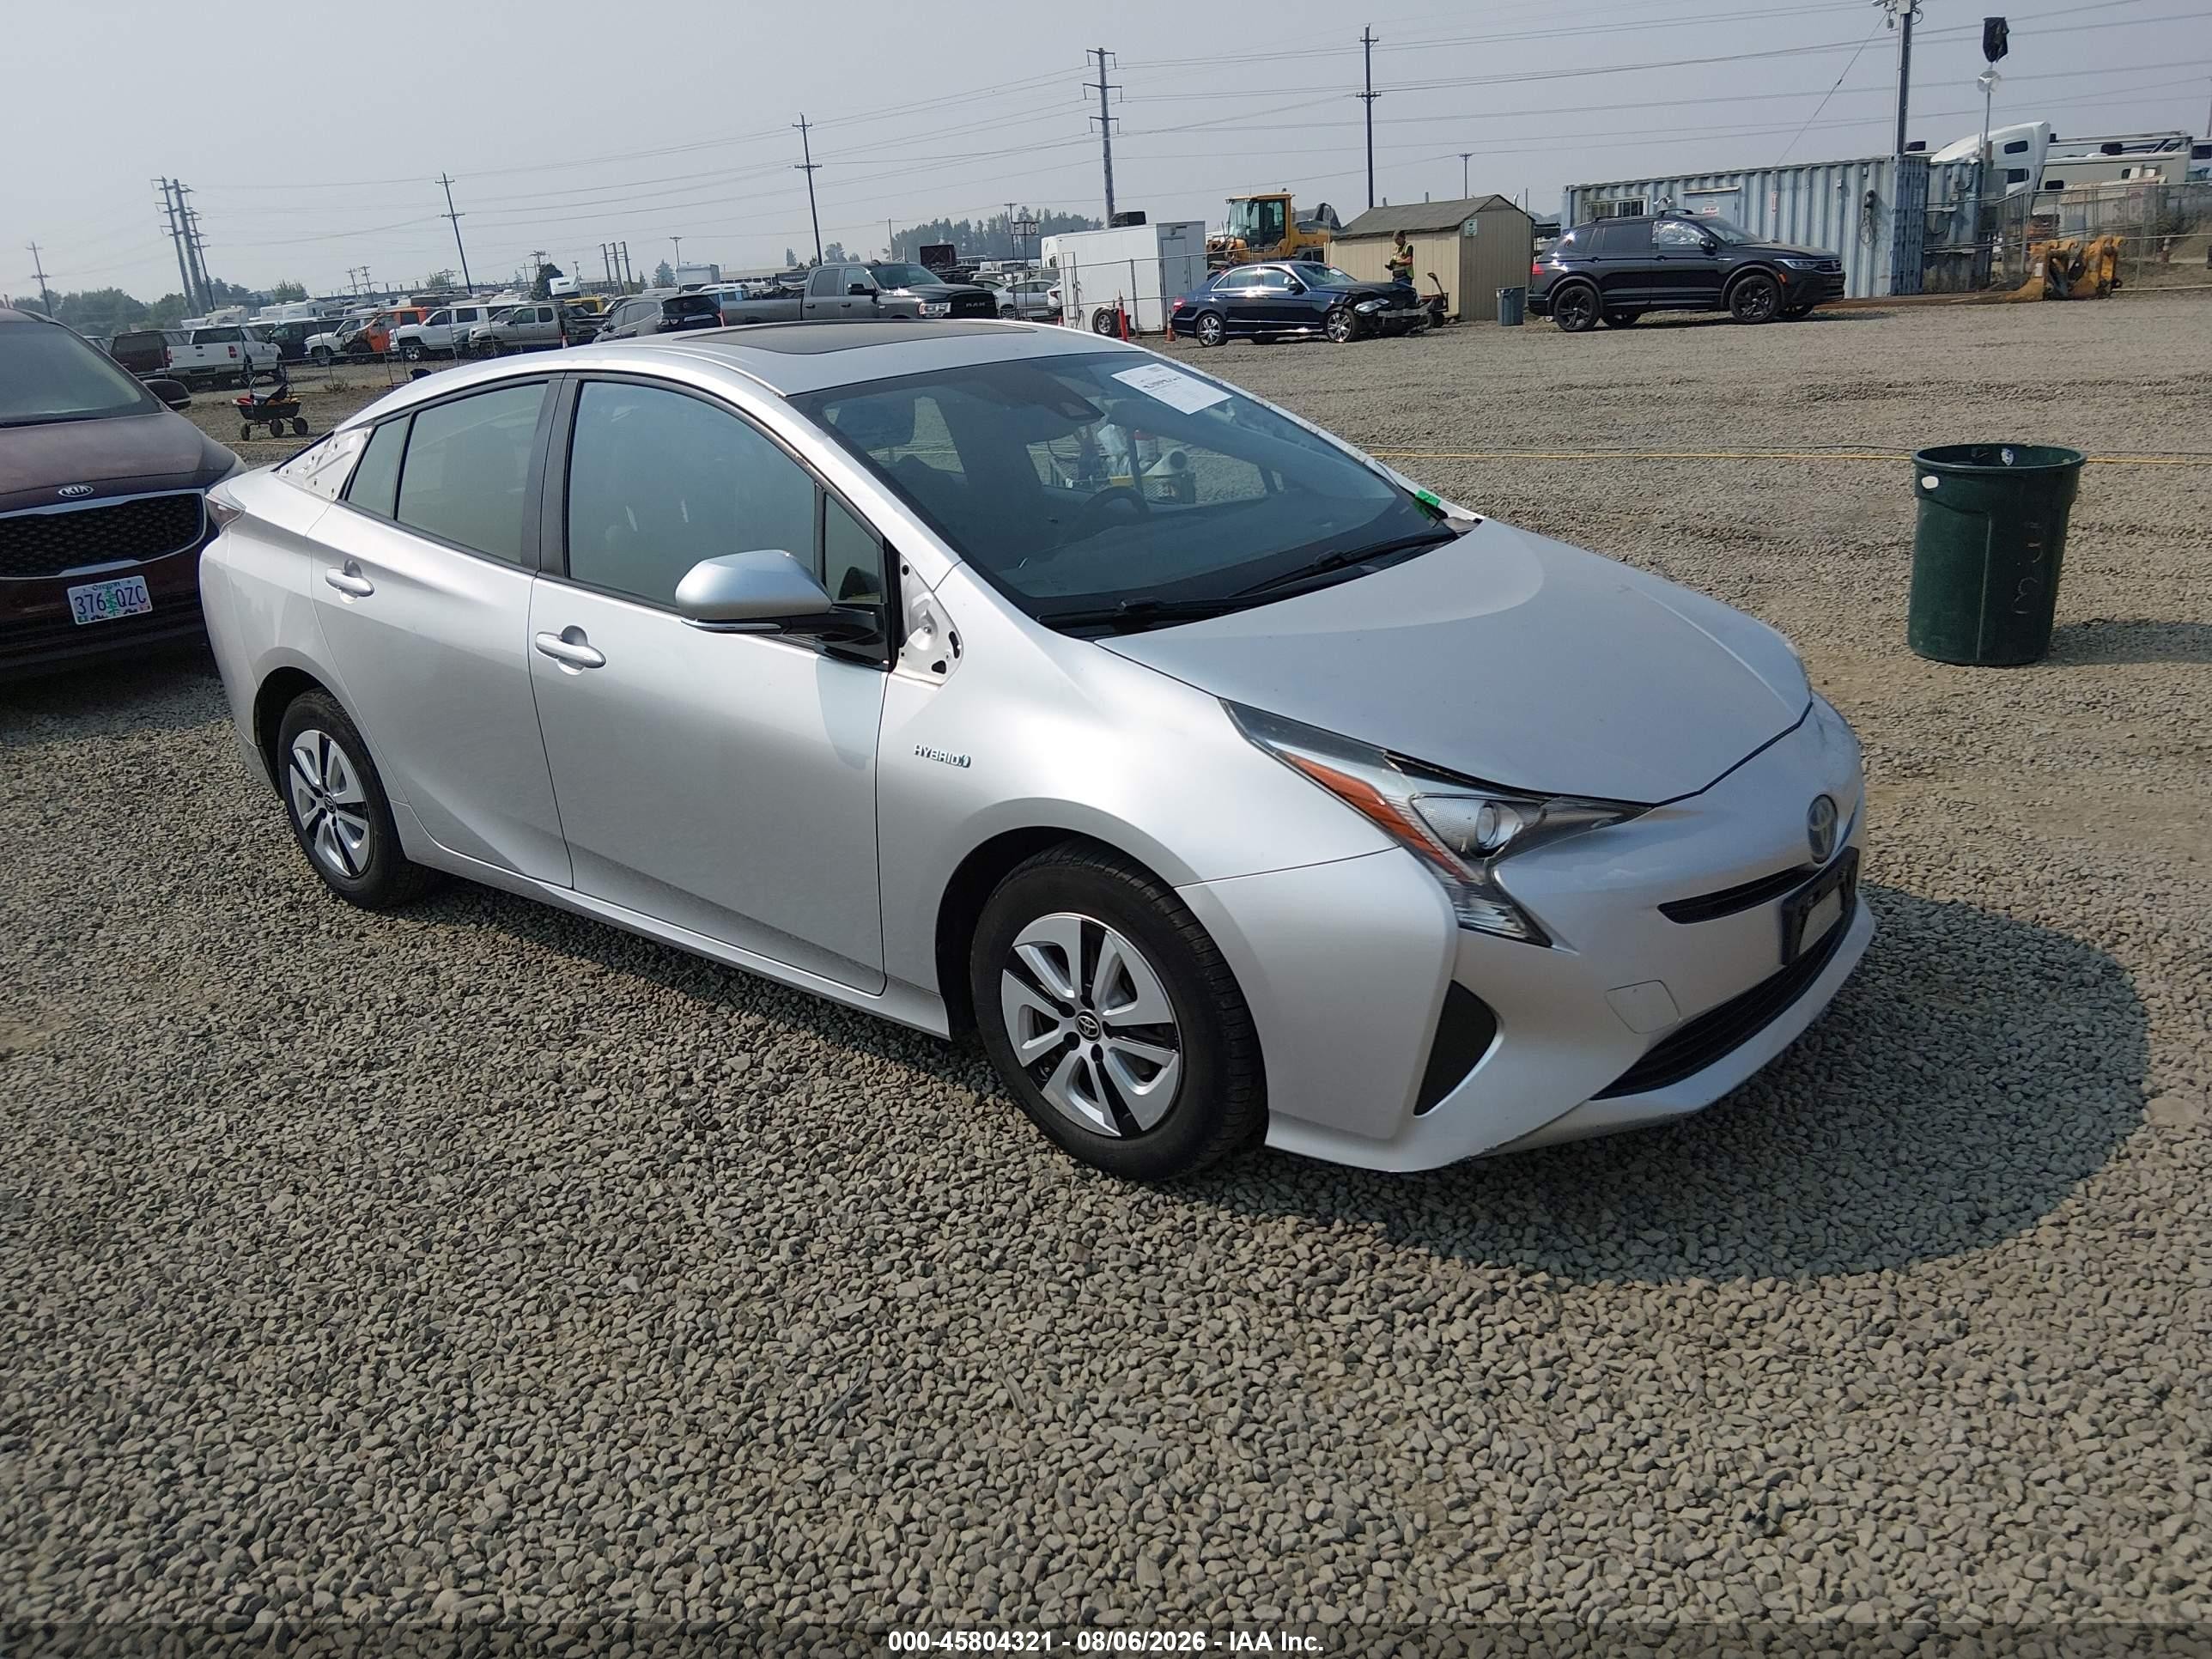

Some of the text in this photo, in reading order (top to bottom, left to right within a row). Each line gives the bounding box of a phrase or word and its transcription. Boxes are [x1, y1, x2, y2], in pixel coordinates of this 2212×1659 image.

[61, 485, 91, 496] KIA
[74, 592, 107, 615] 376
[914, 744, 962, 768] HYBRID
